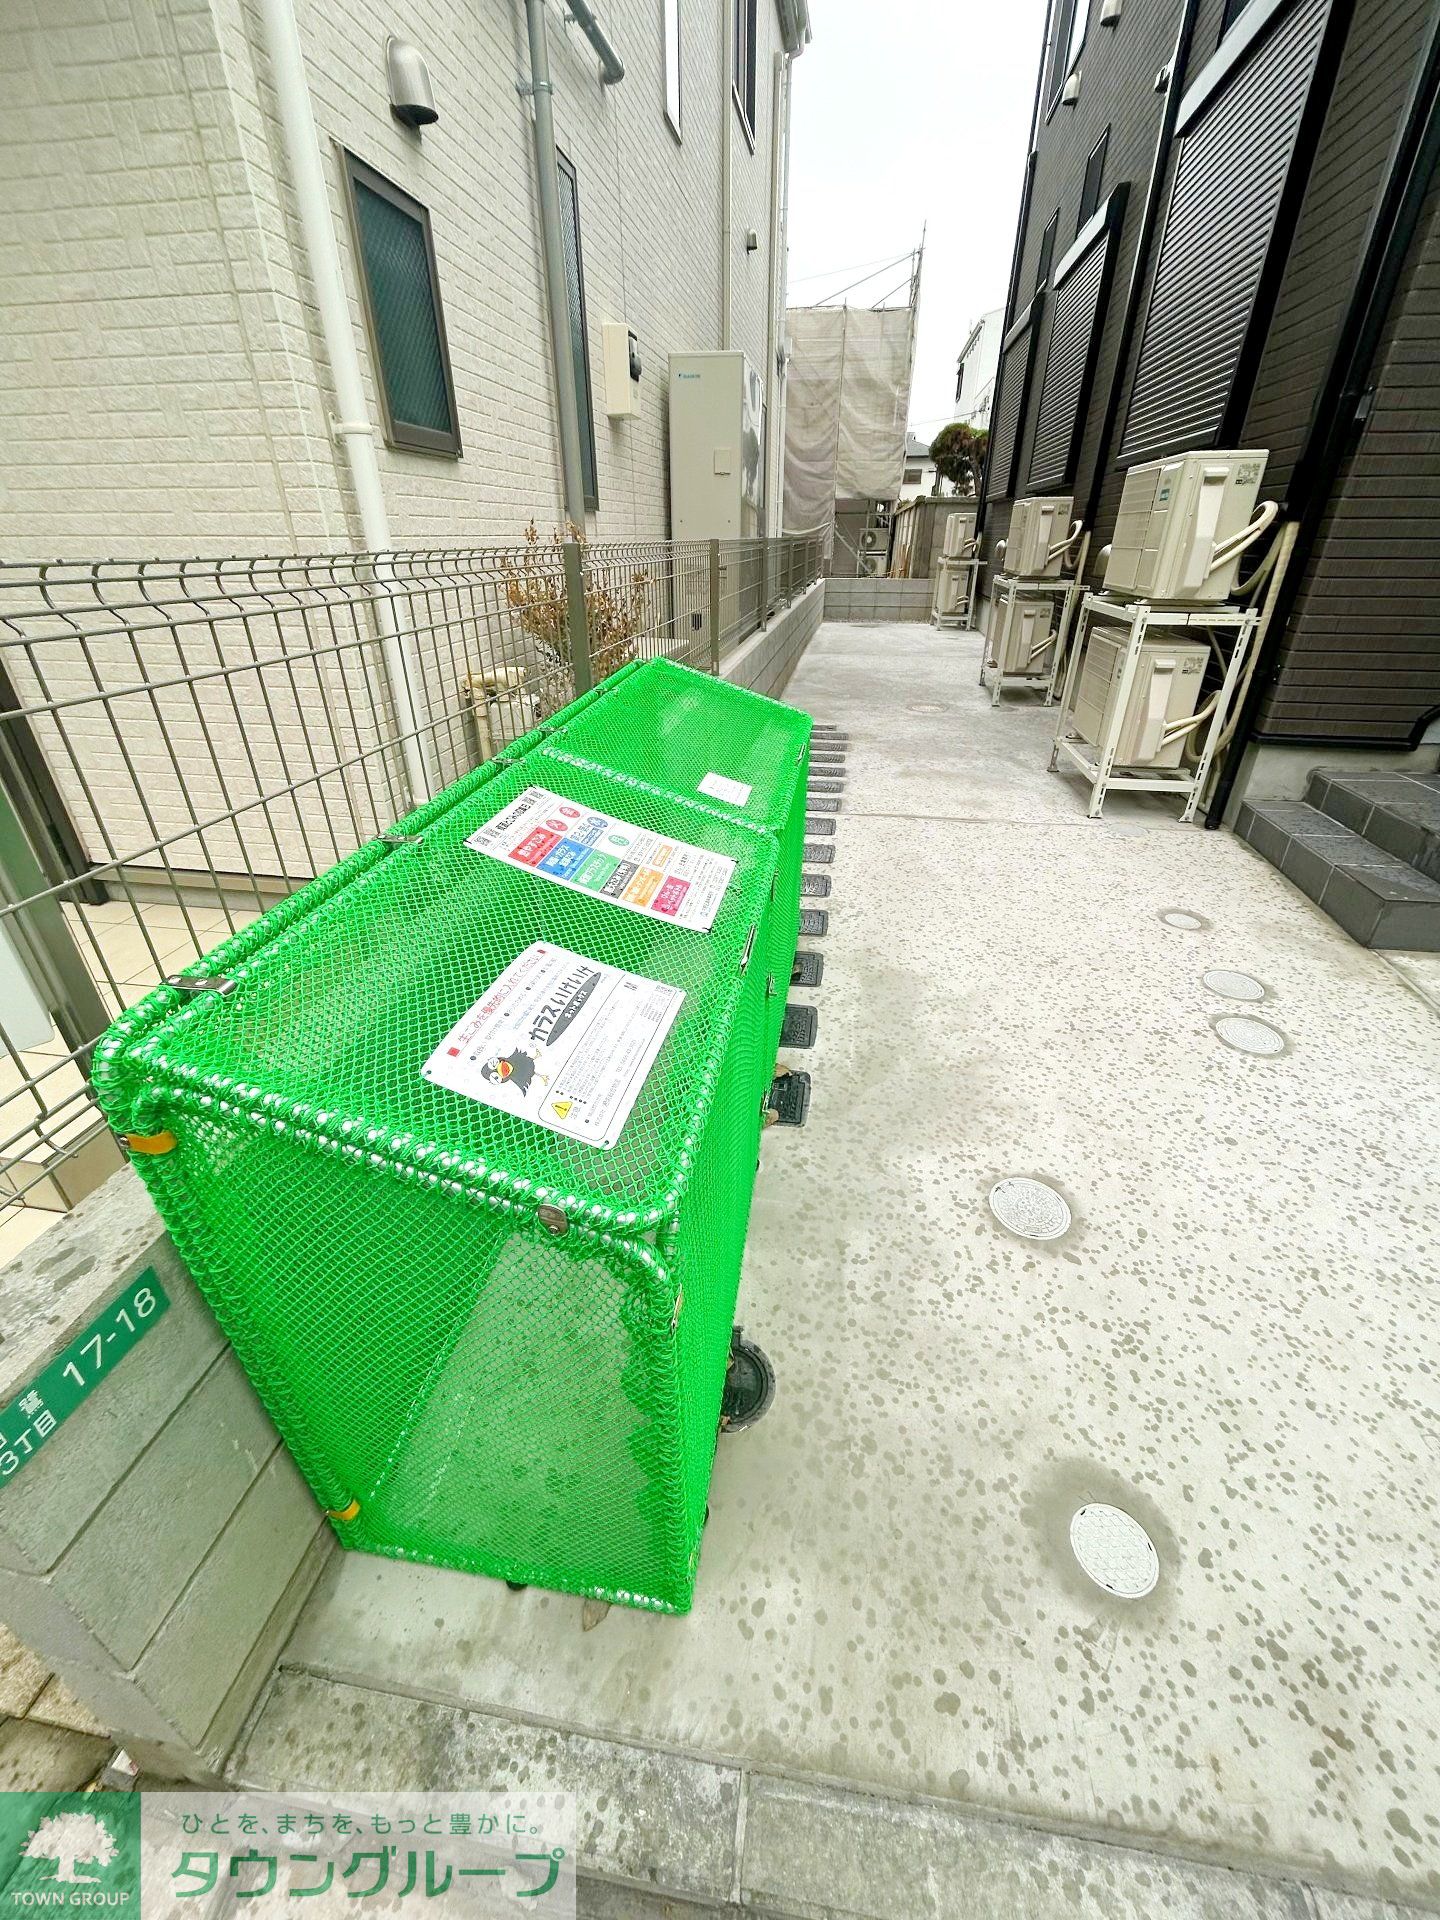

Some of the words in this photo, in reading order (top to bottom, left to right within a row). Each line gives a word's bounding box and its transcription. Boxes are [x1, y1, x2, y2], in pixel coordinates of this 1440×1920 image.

[529, 965, 595, 1043] カラスいけいけ
[62, 1287, 157, 1387] 17-18
